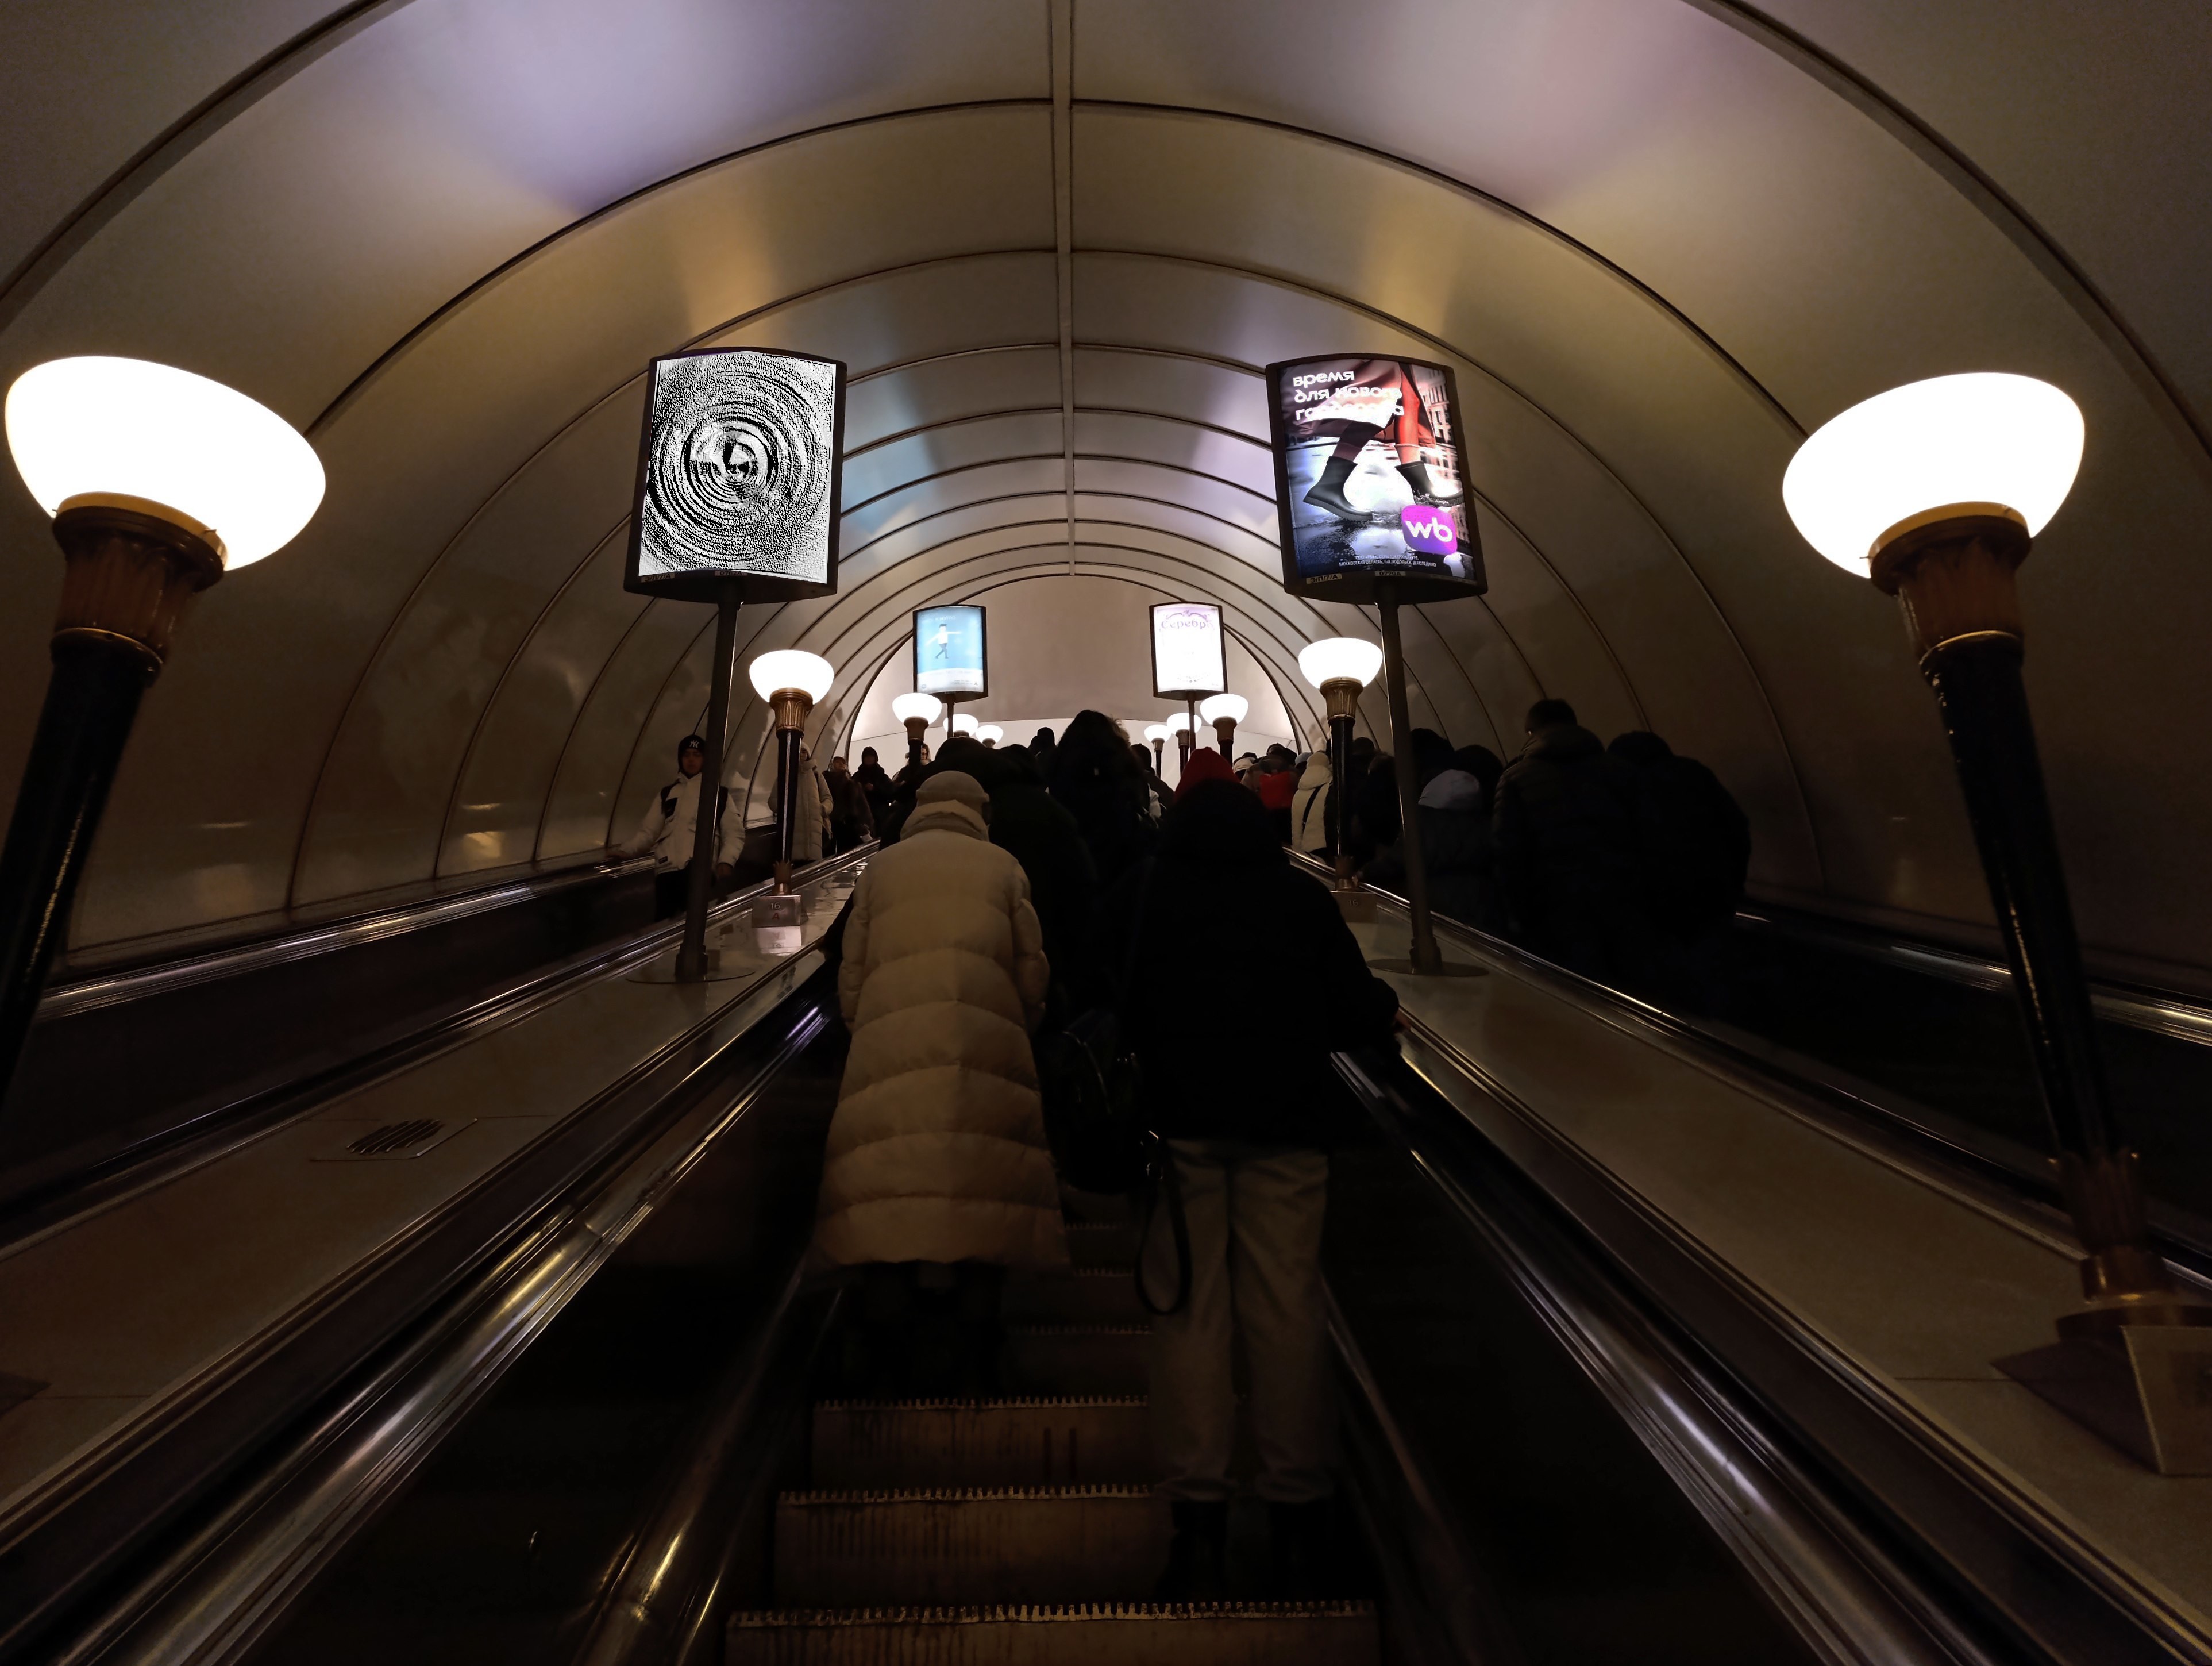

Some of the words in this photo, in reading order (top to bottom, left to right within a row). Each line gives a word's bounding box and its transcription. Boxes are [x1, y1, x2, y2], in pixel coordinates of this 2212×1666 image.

[1293, 371, 1354, 388] время
[1294, 388, 1329, 403] для
[1405, 517, 1453, 542] wb
